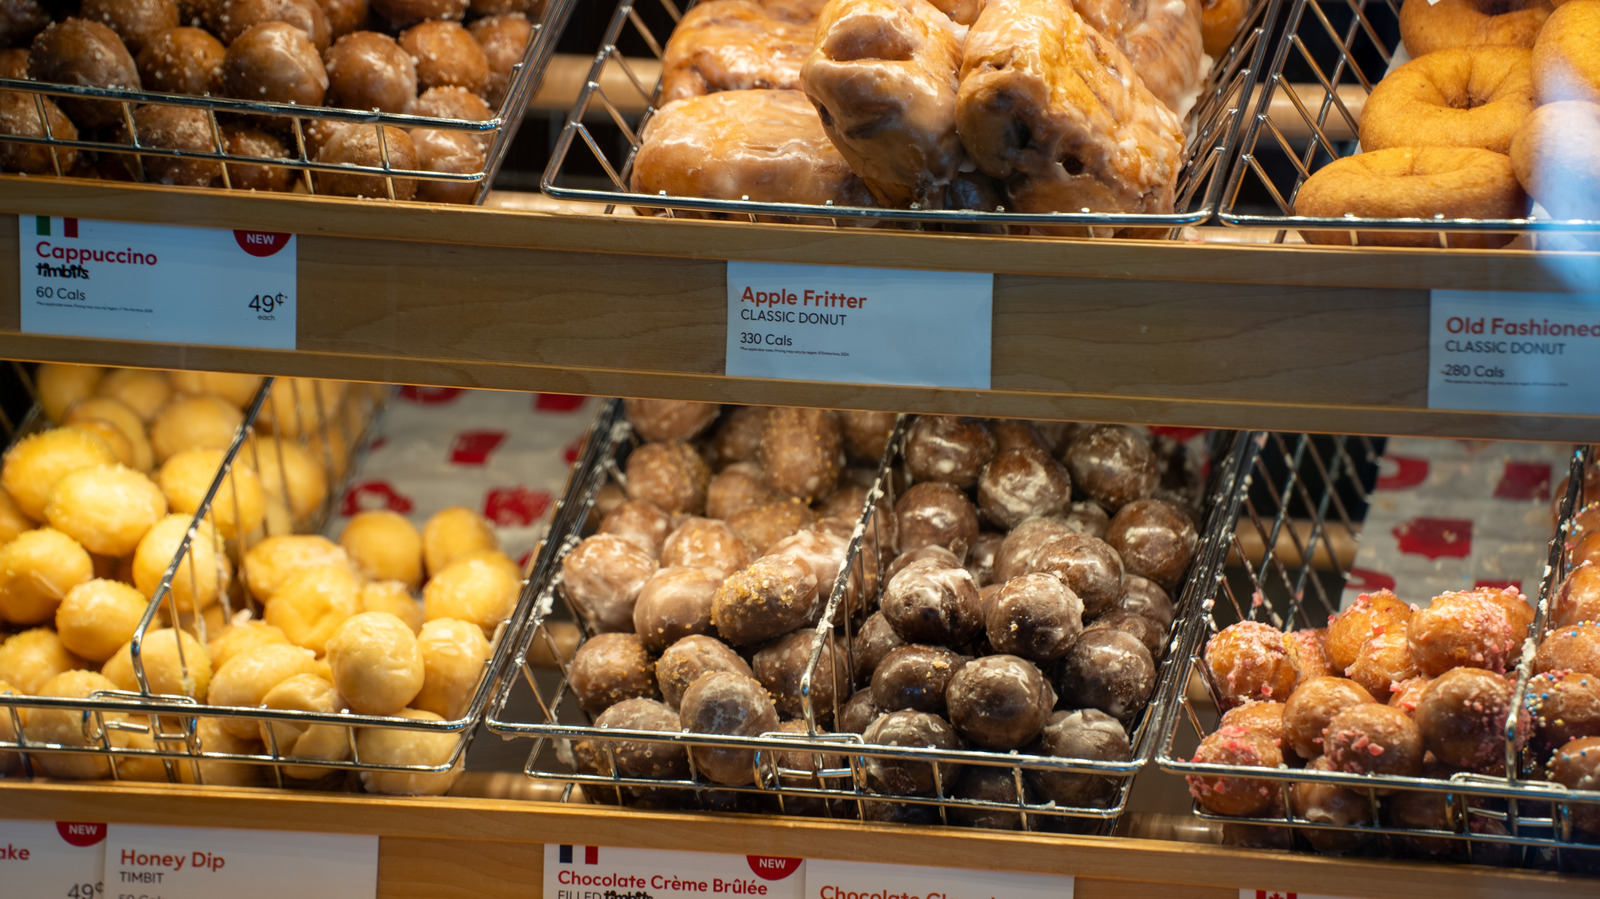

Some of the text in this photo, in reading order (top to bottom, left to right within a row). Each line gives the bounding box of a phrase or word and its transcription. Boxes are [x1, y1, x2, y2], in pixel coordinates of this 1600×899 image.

[246, 233, 275, 245] NEW
[36, 241, 158, 266] Cappuccino
[36, 262, 90, 280] timbits
[36, 286, 86, 301] 60 Cals
[741, 286, 867, 309] Apple Fritter
[257, 313, 276, 321] each
[741, 308, 847, 326] CLASSIC DONUT
[1446, 316, 1600, 338] Old Fashioned
[740, 332, 793, 346] 330 Cals
[1445, 340, 1566, 355] CLASSIC DONUT
[1445, 363, 1505, 378] 280 Cals
[68, 824, 98, 836] NEW
[120, 848, 226, 873] Honey Dip
[758, 858, 787, 869] NEW
[119, 871, 165, 885] TIMBIT
[557, 869, 768, 896] Chocolate Crème Brûlée
[819, 885, 920, 899] Chocolt
